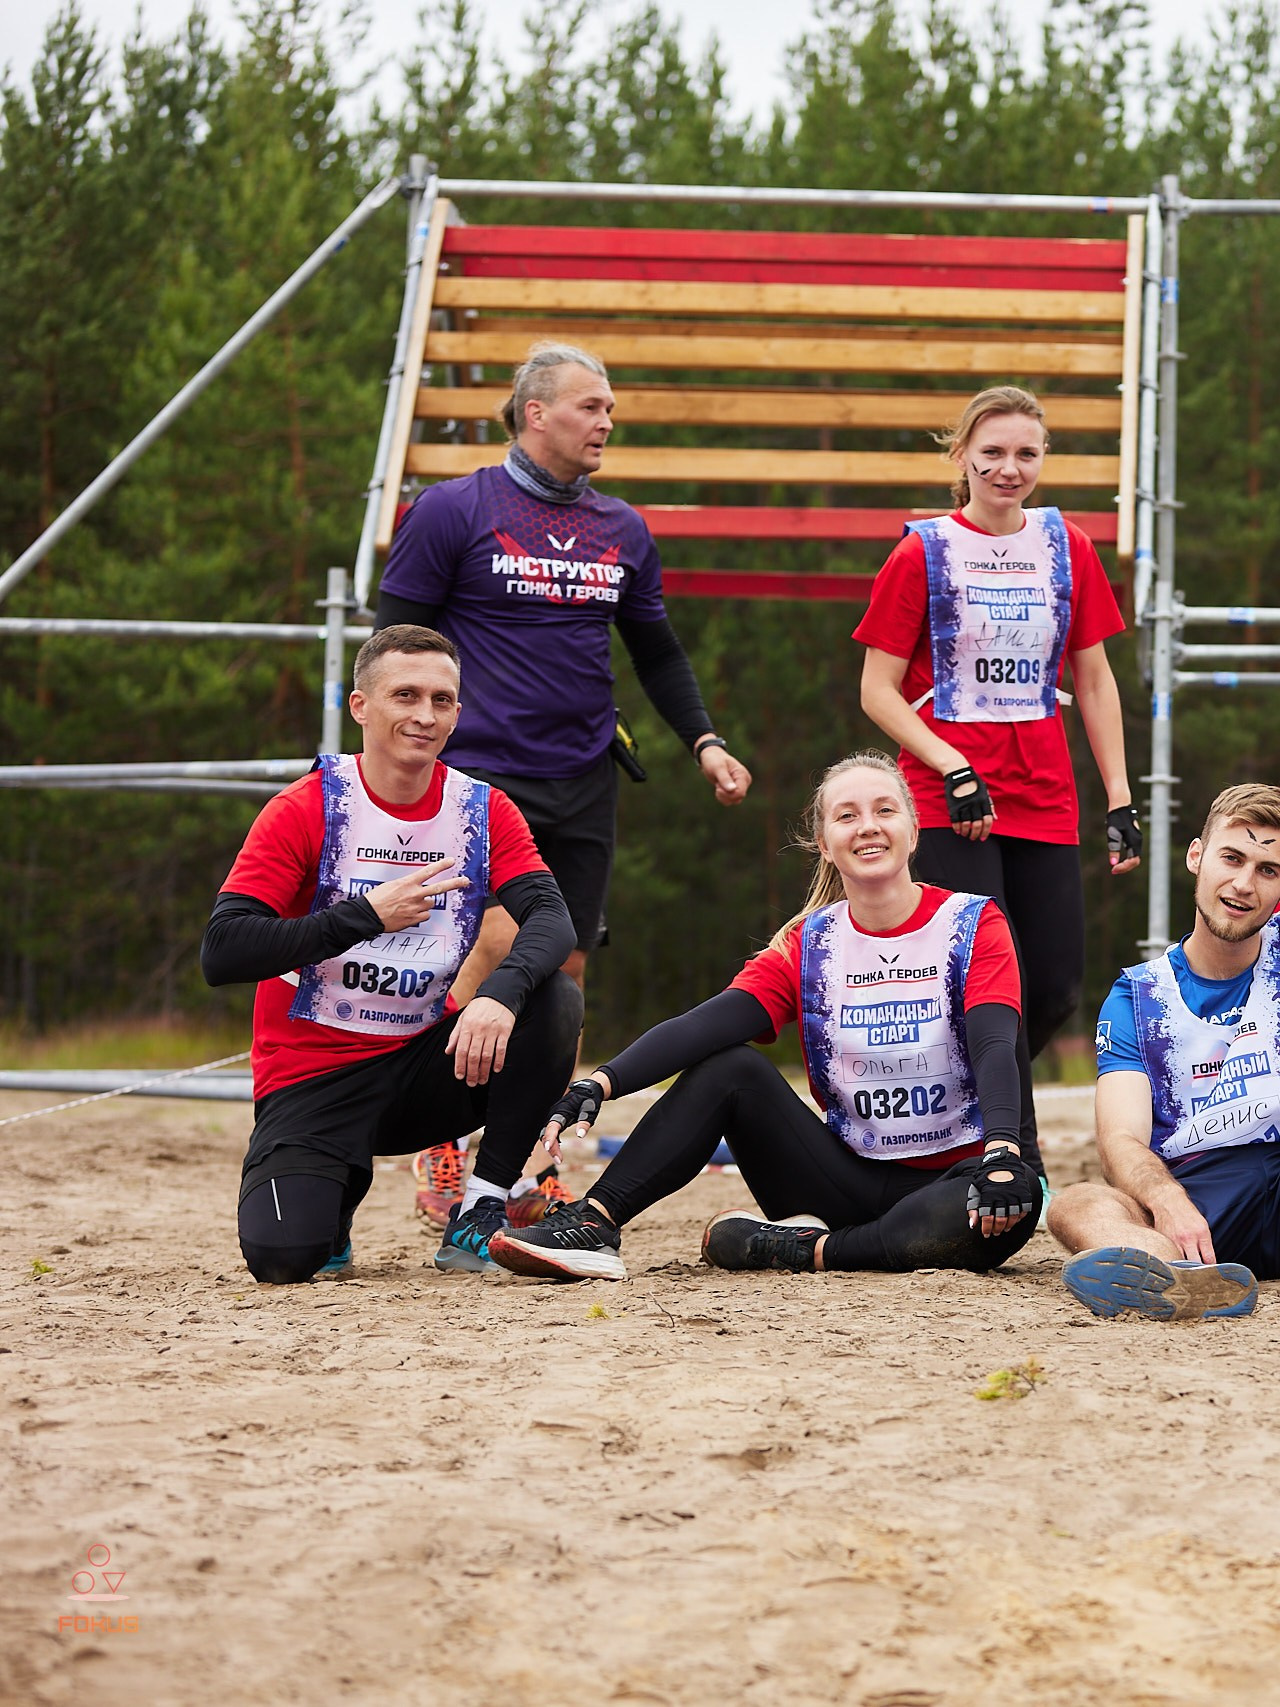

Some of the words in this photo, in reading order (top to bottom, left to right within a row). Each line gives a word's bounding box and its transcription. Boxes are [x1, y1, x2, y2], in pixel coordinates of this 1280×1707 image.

[491, 554, 625, 585] ИНСТРУКТОР
[964, 561, 997, 571] ГОНКА
[999, 562, 1036, 571] ГЕРОЕВ
[506, 580, 562, 597] ГОНКА
[566, 585, 619, 603] ГЕРОЕВ
[968, 588, 1046, 606] КОМАНДНЫЙ
[990, 606, 1028, 620] СТАРТ
[975, 658, 1040, 684] 03209
[993, 698, 1040, 707] ГАЗПРОМБАН
[357, 847, 398, 861] ГОНКА
[342, 962, 435, 998] 03203
[846, 971, 884, 985] ГОНКА
[888, 966, 938, 980] ГЕРОЕВ
[359, 1008, 424, 1025] ГАЗПРОМБАНК
[842, 996, 941, 1025] КОМАНДНЫЙ
[870, 1024, 917, 1044] СТАРТ
[852, 1052, 930, 1077] ОЛЬГА
[1191, 1060, 1224, 1075] ГОНК
[853, 1083, 947, 1120] 03202
[881, 1127, 953, 1146] ГАЗПРОМБАНК
